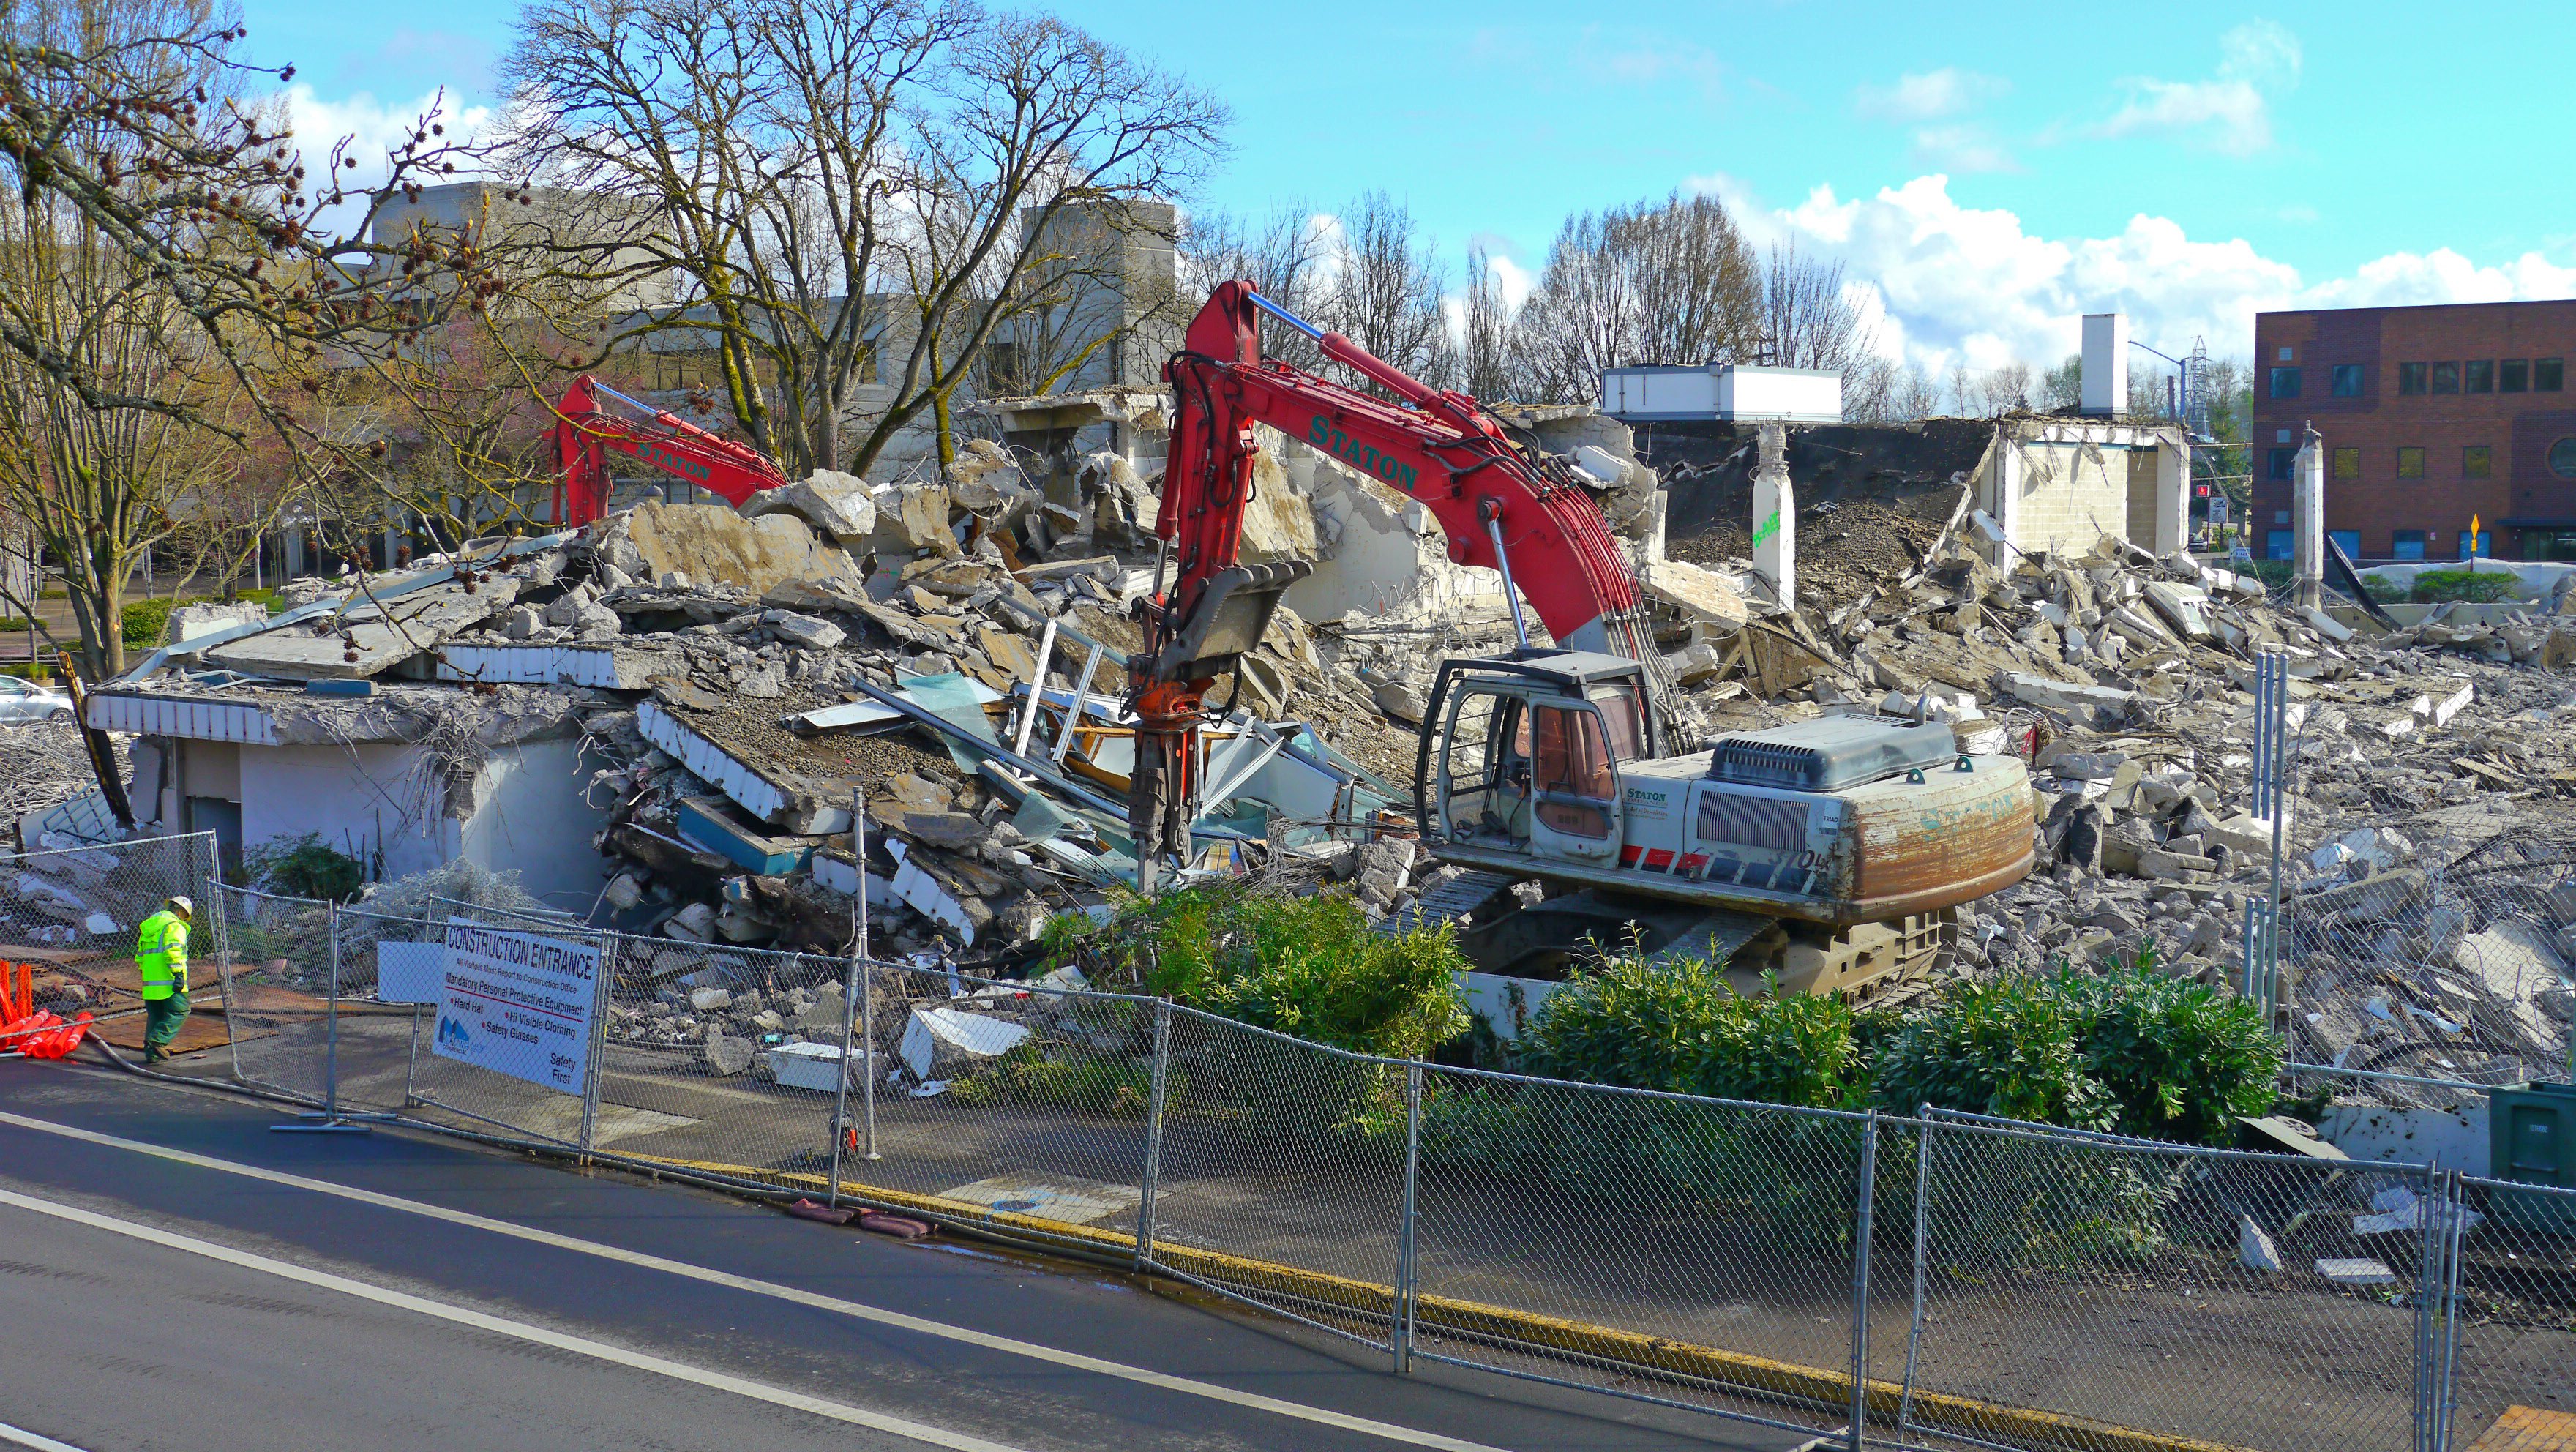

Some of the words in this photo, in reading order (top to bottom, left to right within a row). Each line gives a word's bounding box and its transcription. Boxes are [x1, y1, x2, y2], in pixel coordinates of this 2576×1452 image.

[637, 443, 711, 481] STATON
[1308, 415, 1419, 492] STATON
[1627, 787, 1666, 801] STATON
[449, 927, 530, 966] CONSTRUCTION
[531, 943, 594, 981] ENTRANCE
[465, 959, 483, 972] Visitors
[484, 964, 497, 976] Must
[498, 968, 516, 980] Report
[517, 972, 523, 981] to
[523, 973, 559, 990] Construction
[560, 982, 577, 995] Office
[446, 971, 478, 993] Mandatory
[479, 980, 509, 998] Personal
[509, 987, 544, 1007] Protective
[544, 996, 585, 1017] Equipment:
[454, 997, 471, 1011] Hard
[471, 1001, 484, 1014] Hat
[486, 1021, 509, 1039] Safety
[510, 1027, 539, 1044] Glasses
[509, 1011, 518, 1023] Hi
[519, 1013, 543, 1030] Visible
[544, 1019, 576, 1041] Clothing
[550, 1052, 576, 1073] Safety
[552, 1069, 571, 1085] First
